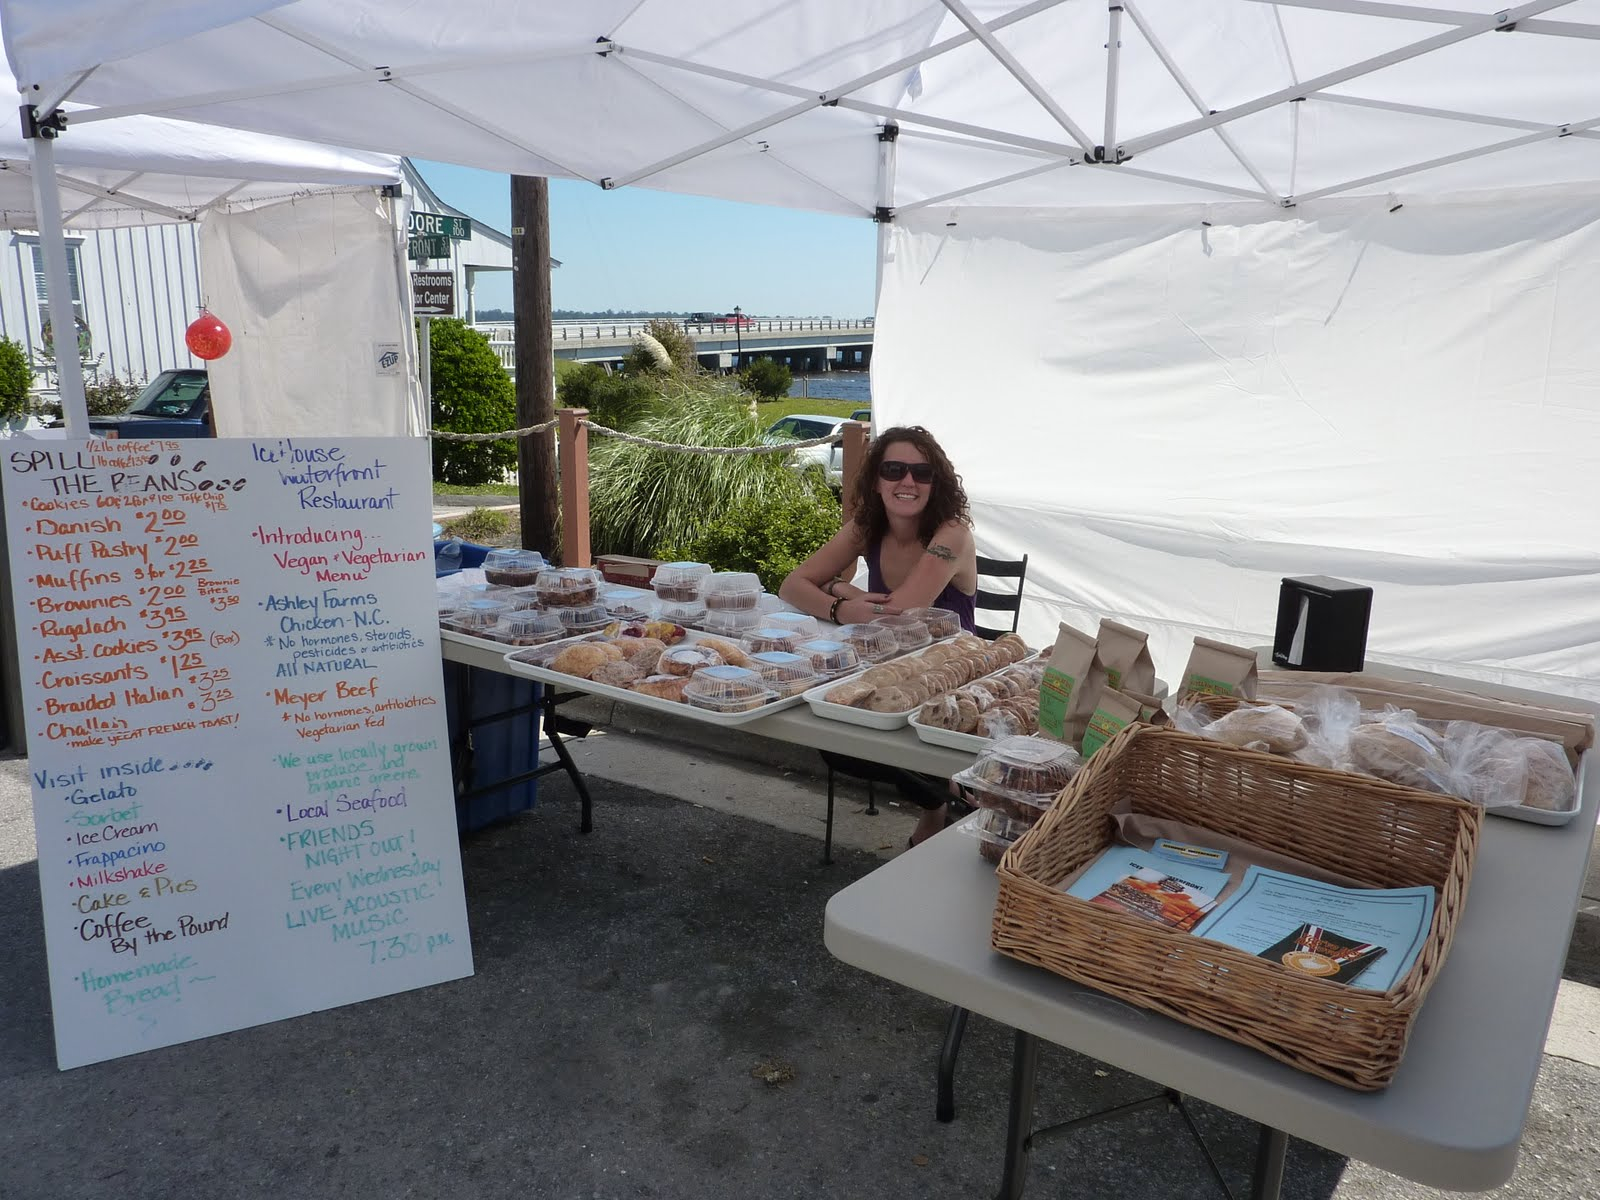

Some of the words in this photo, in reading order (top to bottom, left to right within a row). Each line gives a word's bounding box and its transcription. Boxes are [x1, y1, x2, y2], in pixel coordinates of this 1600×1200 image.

[453, 218, 463, 228] ST
[413, 274, 452, 287] Restrooms
[424, 291, 450, 304] Center
[86, 440, 101, 453] 1/2
[102, 440, 114, 452] lb
[117, 441, 152, 454] coffee
[11, 451, 95, 473] SPILL
[42, 474, 104, 496] THE
[30, 496, 90, 511] Cookies
[298, 486, 401, 510] Restaurant
[36, 516, 122, 535] Danish
[35, 544, 81, 564] Puff
[91, 541, 148, 564] Pastry
[273, 550, 329, 575] Vegan
[342, 548, 427, 573] Vegetarian
[36, 569, 122, 591] Muffins
[134, 568, 145, 579] 3
[147, 565, 166, 582] for
[197, 577, 240, 588] Brownie
[316, 569, 368, 583] Menu
[198, 586, 229, 596] Bites
[264, 594, 319, 619] Ashley
[323, 588, 378, 609] Farms
[37, 594, 132, 614] Brownies
[280, 615, 345, 634] Chicken
[93, 638, 159, 658] Cookies
[278, 636, 296, 650] No
[292, 643, 357, 665] pesticides
[372, 639, 425, 653] antibiotics
[41, 662, 149, 690] Croissants
[303, 658, 378, 675] NATURAL
[45, 691, 116, 716] Braided
[124, 686, 184, 707] Italian
[274, 687, 328, 711] Meyer
[336, 676, 380, 699] Beef
[294, 713, 311, 724] No
[375, 695, 437, 712] antibiotics
[71, 736, 106, 748] make
[148, 721, 196, 736] FRENCH
[296, 722, 360, 743] Vegetarian
[278, 754, 301, 769] We
[306, 752, 334, 766] use
[338, 740, 387, 761] locally
[392, 740, 438, 754] grown
[34, 765, 88, 790] Visit
[70, 782, 138, 805] Gelato
[286, 800, 329, 823] Local
[336, 786, 408, 813] Seafood
[71, 802, 144, 827] Sorbet
[287, 820, 375, 851] FRIENDS
[76, 841, 166, 868] Frappacino
[304, 843, 366, 870] NIGHT
[76, 861, 169, 890] Milkshake
[290, 879, 342, 901] Every
[346, 858, 443, 889] Wednesday
[78, 892, 132, 915] Cake
[154, 876, 198, 897] Pies
[286, 904, 337, 930] LIVE
[342, 882, 436, 916] ACOUSTIC
[80, 911, 152, 942] Coffee
[110, 936, 138, 957] By
[144, 927, 176, 946] the
[178, 912, 230, 938] Pound
[81, 951, 199, 993] Homemade
